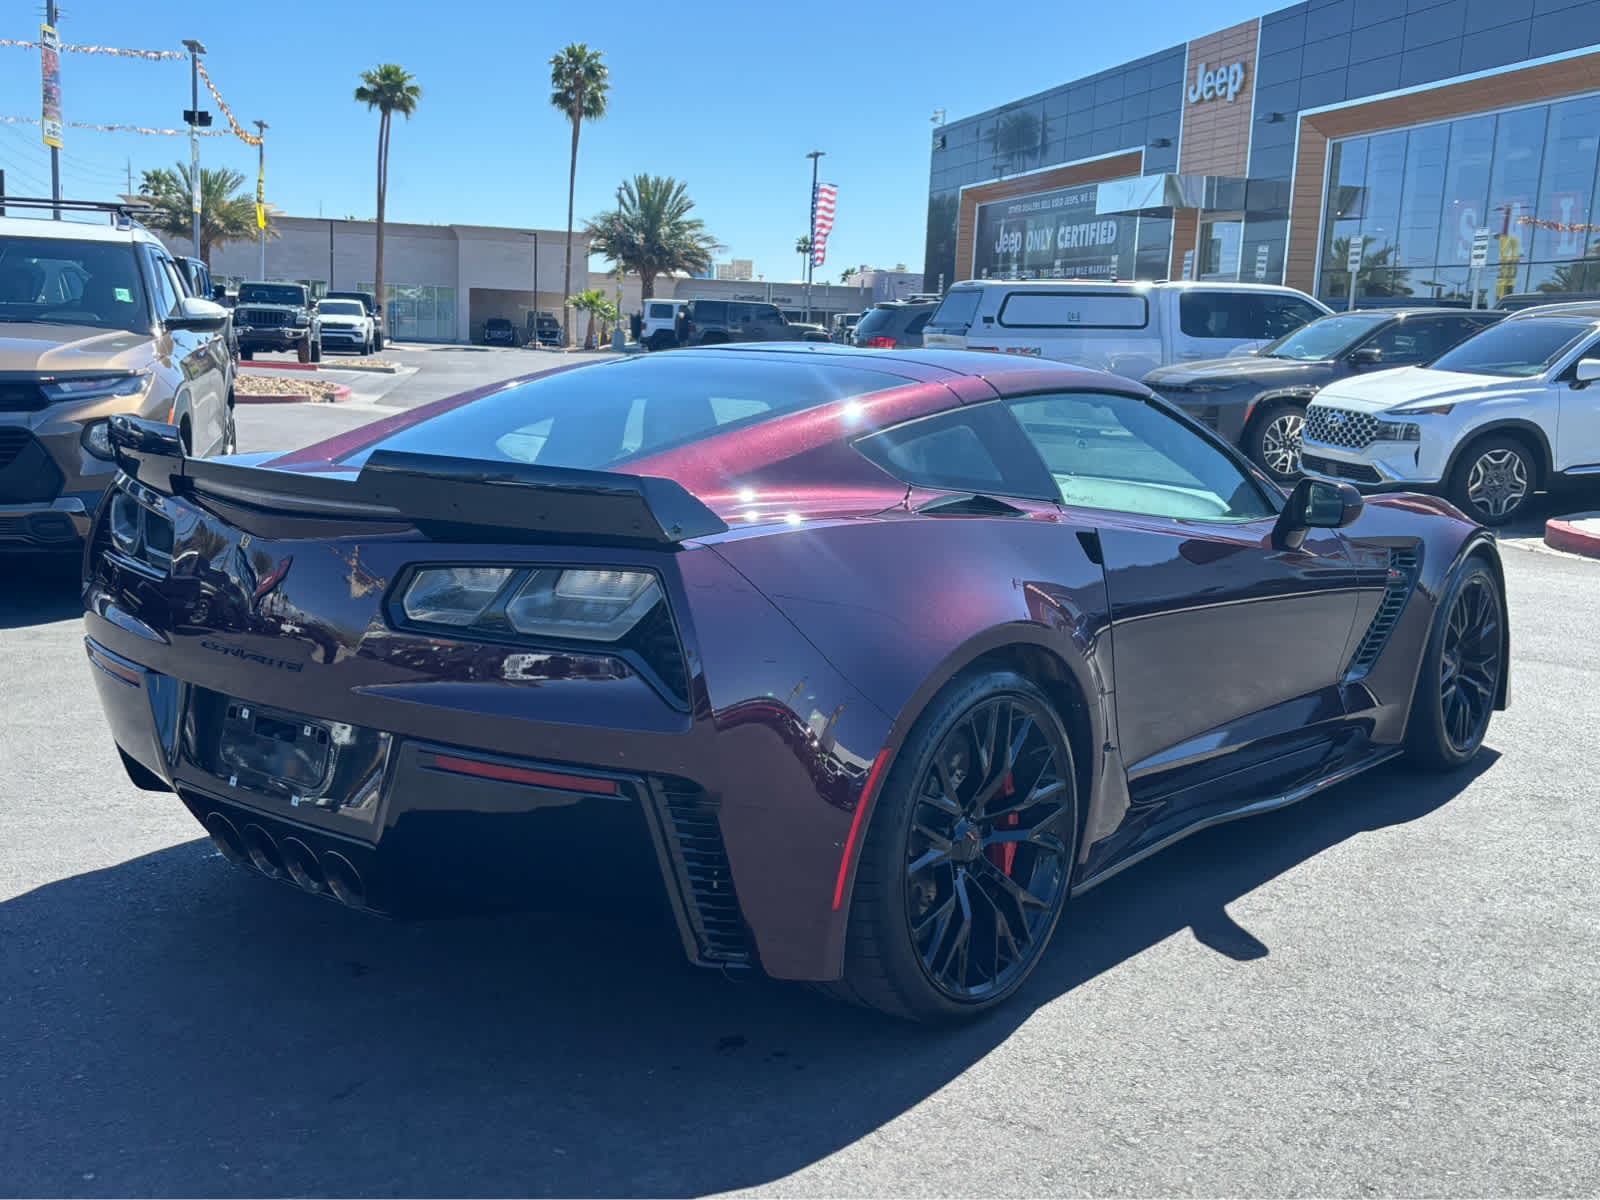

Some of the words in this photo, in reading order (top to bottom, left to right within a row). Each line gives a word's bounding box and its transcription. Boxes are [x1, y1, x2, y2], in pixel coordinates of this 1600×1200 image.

[1188, 63, 1244, 103] Jeep
[995, 225, 1022, 256] Jeep
[1026, 228, 1054, 252] ONLY
[1057, 220, 1117, 249] CERTIFIED
